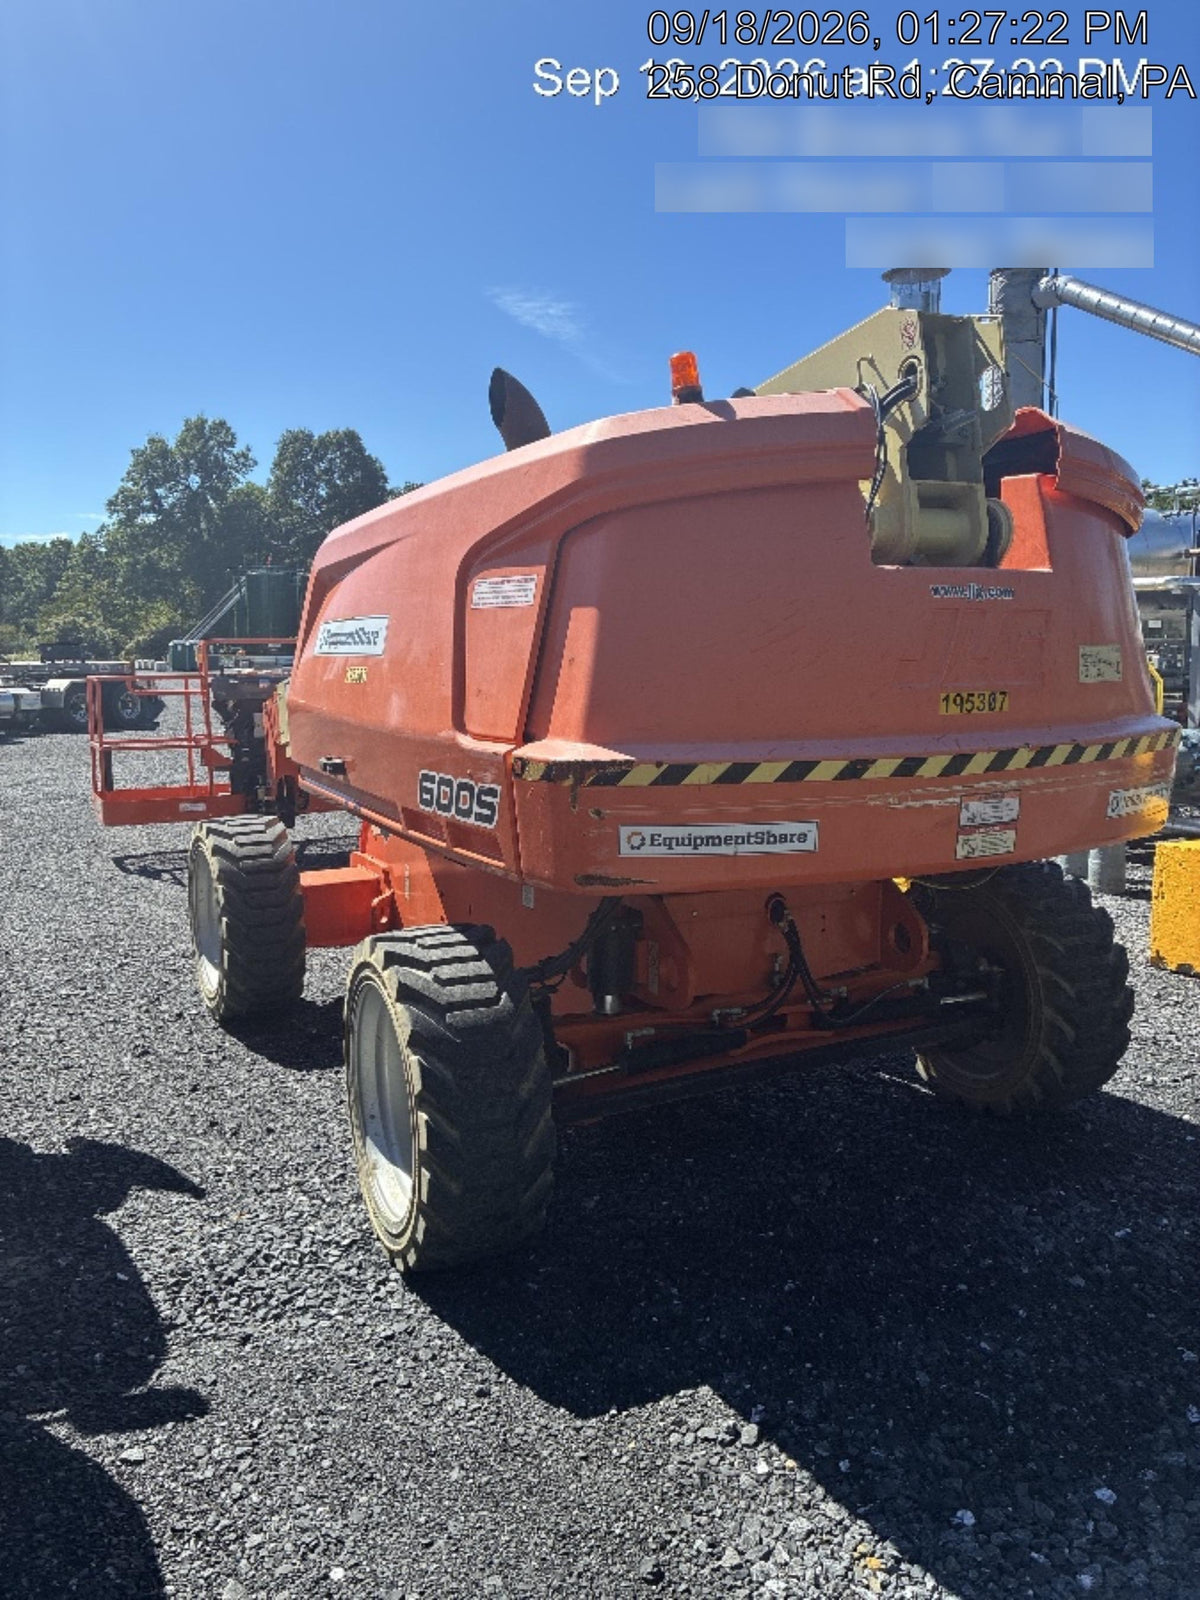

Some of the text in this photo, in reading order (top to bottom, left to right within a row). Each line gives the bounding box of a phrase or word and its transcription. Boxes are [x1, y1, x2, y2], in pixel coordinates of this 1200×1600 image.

[942, 691, 1008, 714] 195307
[418, 770, 501, 829] 600S
[650, 831, 808, 850] EquipmentShare
